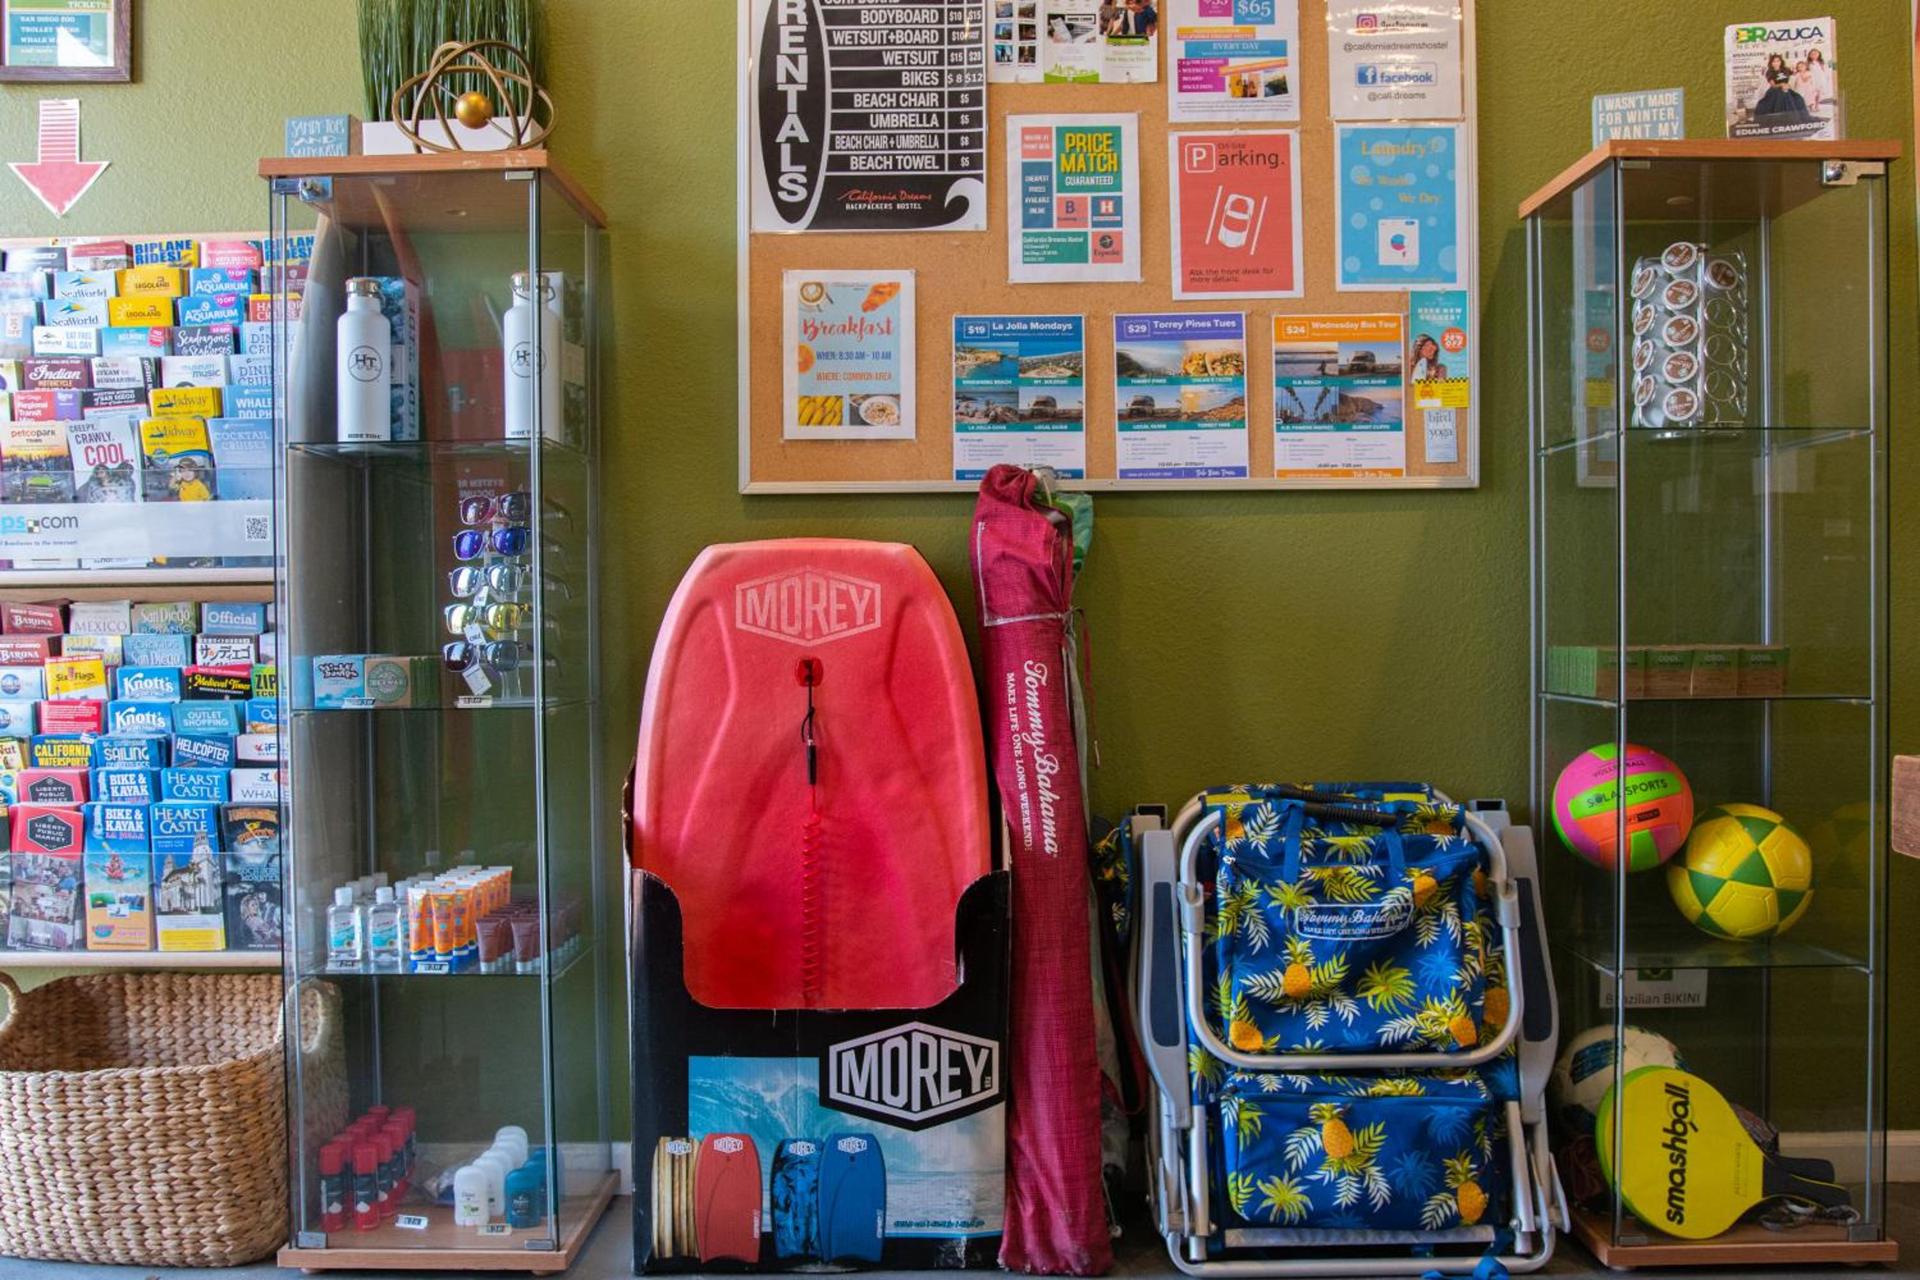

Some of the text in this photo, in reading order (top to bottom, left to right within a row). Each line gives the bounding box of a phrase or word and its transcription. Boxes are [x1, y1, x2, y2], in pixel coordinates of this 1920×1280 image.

[1238, 0, 1272, 17] $65
[860, 9, 982, 24] BODYBOARD $10 $15
[832, 30, 939, 45] WETSUIT+BOARD
[1736, 26, 1823, 43] BRAZUCA
[882, 51, 939, 66] WETSUIT
[950, 53, 963, 62] $15
[901, 72, 983, 86] BIKES $12
[1380, 72, 1433, 83] facebook
[775, 0, 809, 203] RENTALS
[853, 93, 969, 107] BEACH CHAIR $5
[1604, 95, 1646, 109] WASN'T
[1648, 92, 1679, 106] MADE
[869, 113, 969, 128] UMBRELLA $5
[1599, 112, 1622, 126] FOR
[1610, 124, 1651, 140] WANT
[1658, 121, 1679, 137] MY
[1736, 121, 1826, 136] EDIANE CRAWFORD
[835, 136, 862, 149] BEACH
[863, 136, 888, 149] CHAIR
[896, 135, 939, 149] UMBRELLA
[1065, 133, 1113, 152] PRICE
[850, 155, 969, 170] BEACH TOWEL $5
[1060, 153, 1118, 173] MATCH
[1192, 149, 1207, 168] P
[1065, 176, 1114, 186] GUARANTEED
[135, 240, 192, 253] BIPLANE
[135, 251, 181, 265] RIDES!
[135, 281, 170, 289] LEGOLAND
[195, 281, 248, 294] AQUARIUM
[51, 315, 98, 327] SeaWorld
[126, 310, 161, 318] LEGOLAND
[185, 309, 239, 323] AQUARIUM
[803, 316, 894, 342] Breakfast
[967, 325, 986, 334] $19
[1005, 322, 1028, 331] Jolla
[1030, 322, 1073, 332] Mondays
[1127, 319, 1237, 334] $29 Torrey Pines Tues
[1311, 321, 1359, 331] Wednesday
[1360, 320, 1377, 329] Bus
[1379, 320, 1398, 329] Tour
[178, 330, 230, 347] Seadragons
[816, 351, 836, 360] WHEN:
[28, 364, 81, 380] Indian
[192, 370, 222, 378] music
[11, 429, 55, 437] petcopark
[745, 571, 872, 639] MOREY
[13, 614, 53, 627] BARONA
[208, 611, 256, 625] Official
[74, 621, 128, 633] MEXICO
[0, 649, 40, 661] BARONA
[123, 671, 174, 695] Knott's
[193, 673, 228, 688] Medieval
[115, 706, 166, 731] Knott's
[186, 711, 223, 719] OUTLET
[183, 718, 229, 728] SHOPPING
[1006, 672, 1027, 790] MAKE LIFE ONE LONG
[35, 743, 92, 757] CALIFORNIA
[176, 737, 230, 762] HELICOPTER
[1022, 660, 1061, 856] Tommy Bahama
[110, 773, 147, 785] BIKE &
[167, 771, 221, 786] HEARST
[111, 785, 150, 796] KAYAK
[172, 784, 222, 799] CASTLE
[1625, 779, 1668, 796] SPORTS
[105, 808, 143, 820] BIKE &
[154, 807, 208, 821] HEARST
[35, 822, 66, 831] LIBERTY
[37, 828, 64, 837] PUBLIC
[106, 820, 145, 832] KAYAK
[159, 820, 208, 835] CASTLE
[35, 834, 67, 843] MARKET
[1300, 910, 1348, 926] Tommy
[1605, 992, 1659, 1005] Bazilian
[841, 1031, 990, 1113] MOREY
[714, 1137, 743, 1152] MOREY
[838, 1137, 867, 1152] MOREY
[1662, 1081, 1698, 1226] smashball
